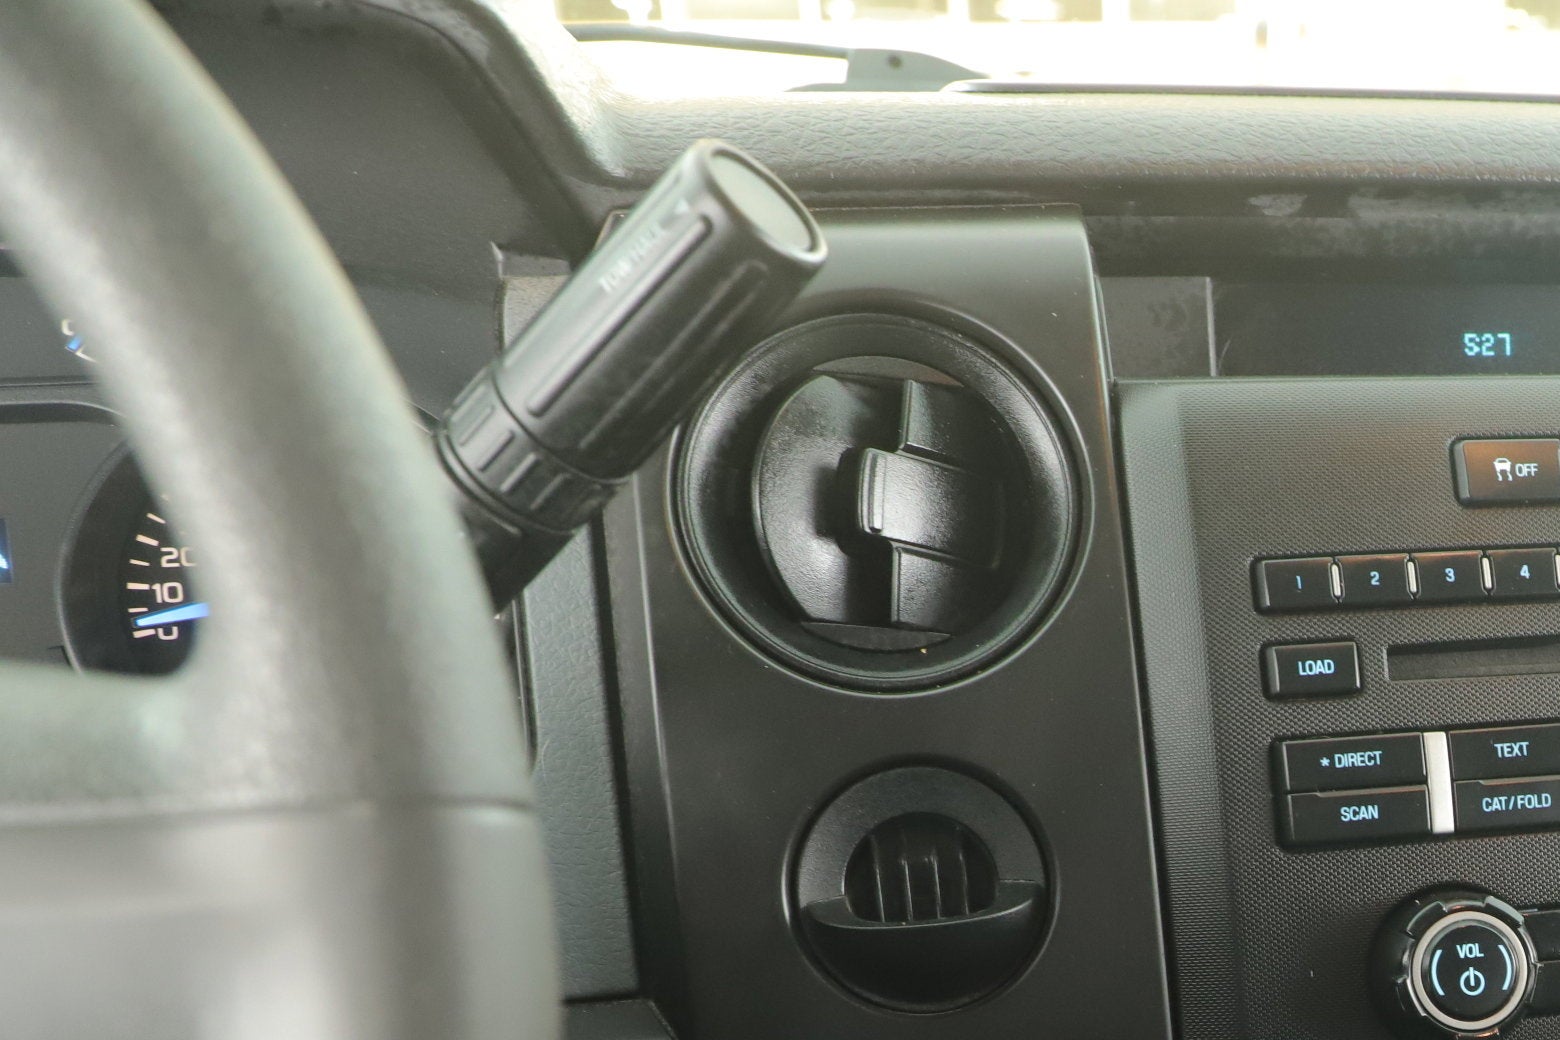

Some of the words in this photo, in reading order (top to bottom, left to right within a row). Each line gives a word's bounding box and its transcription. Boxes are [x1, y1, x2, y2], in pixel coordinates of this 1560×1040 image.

[1515, 463, 1538, 477] OFF
[1295, 575, 1302, 590] 1
[1370, 571, 1380, 586] 2
[1445, 567, 1456, 582] 3
[1519, 564, 1531, 579] 4
[150, 581, 184, 604] 10
[1298, 659, 1335, 676] LOAD
[1493, 741, 1529, 758] TEXT
[1334, 750, 1382, 768] DIRECT
[1482, 793, 1552, 812] CAT/FOLD
[1340, 804, 1379, 822] SCAN
[1456, 942, 1485, 959] VOL
